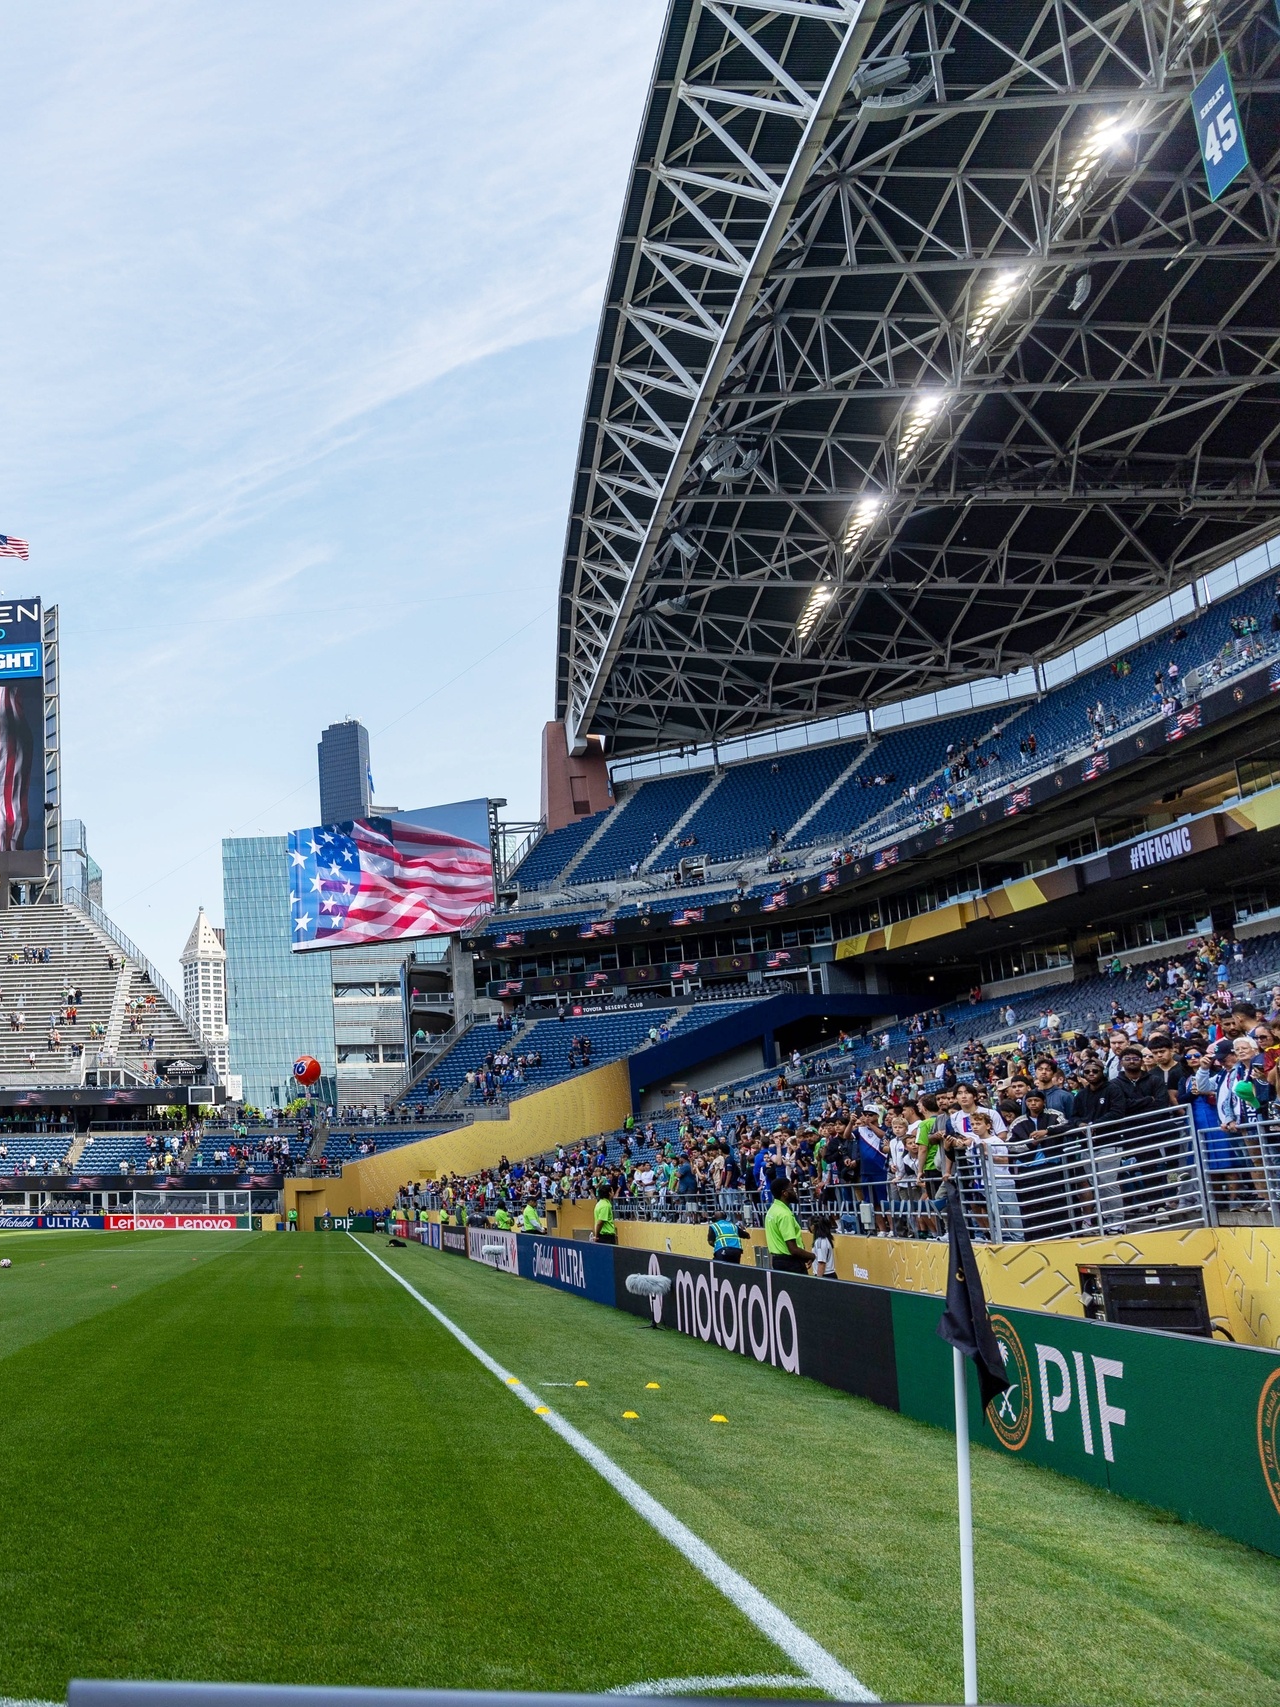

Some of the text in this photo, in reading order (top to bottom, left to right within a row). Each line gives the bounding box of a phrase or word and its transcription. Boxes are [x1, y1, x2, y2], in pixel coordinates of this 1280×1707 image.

[1205, 101, 1238, 165] 45
[1130, 826, 1191, 870] #FIFACWC
[498, 883, 518, 892] 300
[46, 1217, 89, 1228] ULTRA
[110, 1218, 165, 1229] Lenovo
[175, 1218, 231, 1230] Lenovo
[334, 1219, 354, 1229] PIF
[533, 1242, 586, 1289] Michelob ULTRA
[675, 1261, 800, 1375] motorola
[1034, 1343, 1127, 1463] PIF
